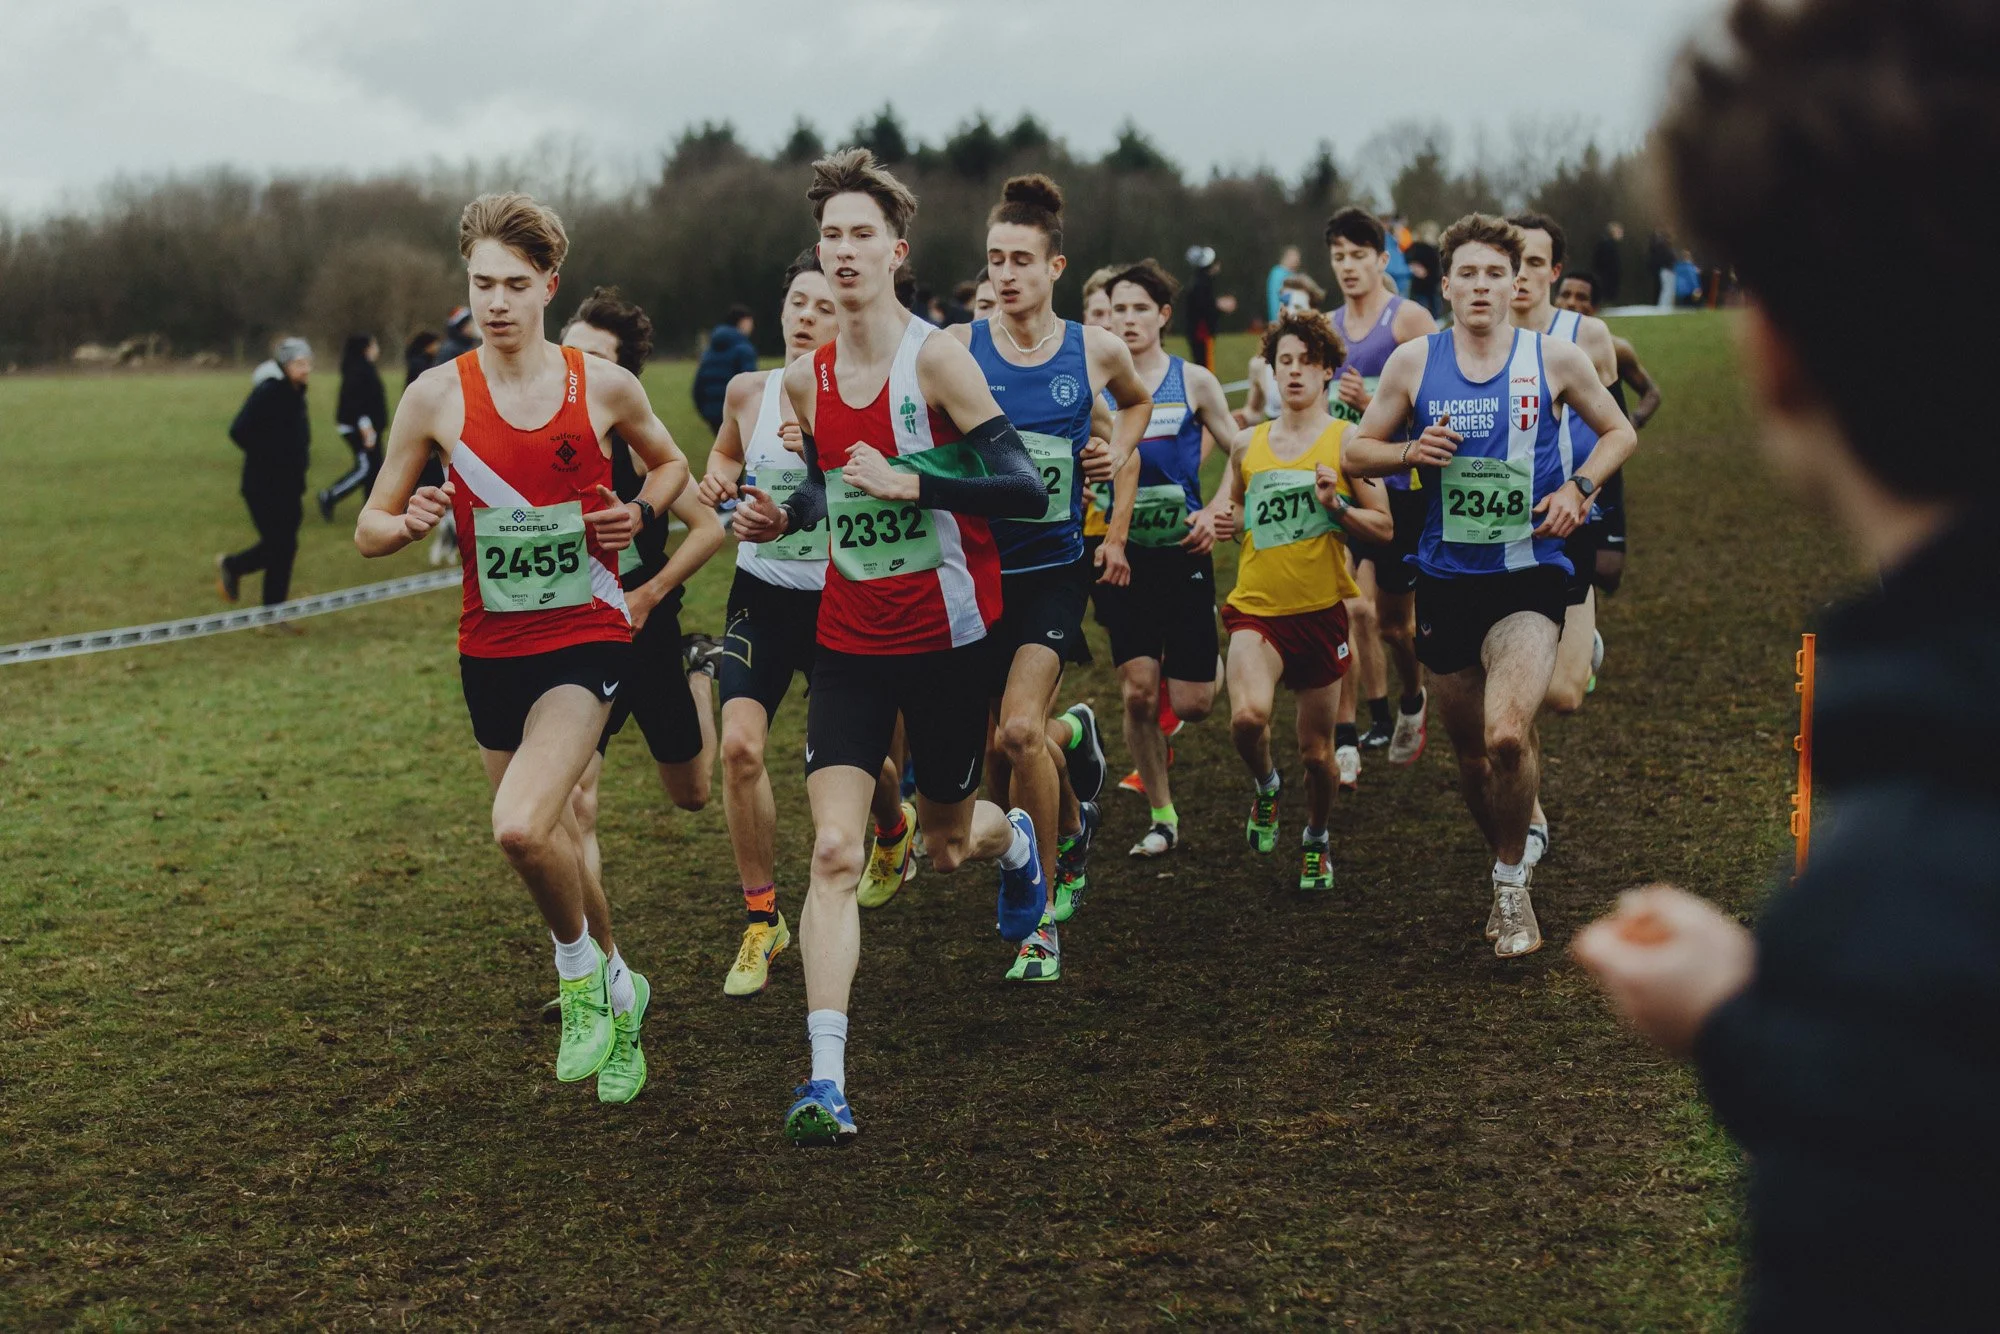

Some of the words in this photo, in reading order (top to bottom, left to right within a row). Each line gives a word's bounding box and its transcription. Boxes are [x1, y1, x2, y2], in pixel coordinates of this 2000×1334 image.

[568, 370, 578, 403] soar
[821, 363, 829, 392] soar
[1429, 398, 1499, 416] BLACKBURN
[1433, 414, 1495, 432] HRRIERS
[1472, 430, 1489, 438] CLUB
[1257, 491, 1316, 525] 2371
[1448, 489, 1524, 518] 2348
[499, 523, 558, 532] SEDGEFIELD
[837, 506, 926, 548] 2332
[486, 542, 579, 579] 2455
